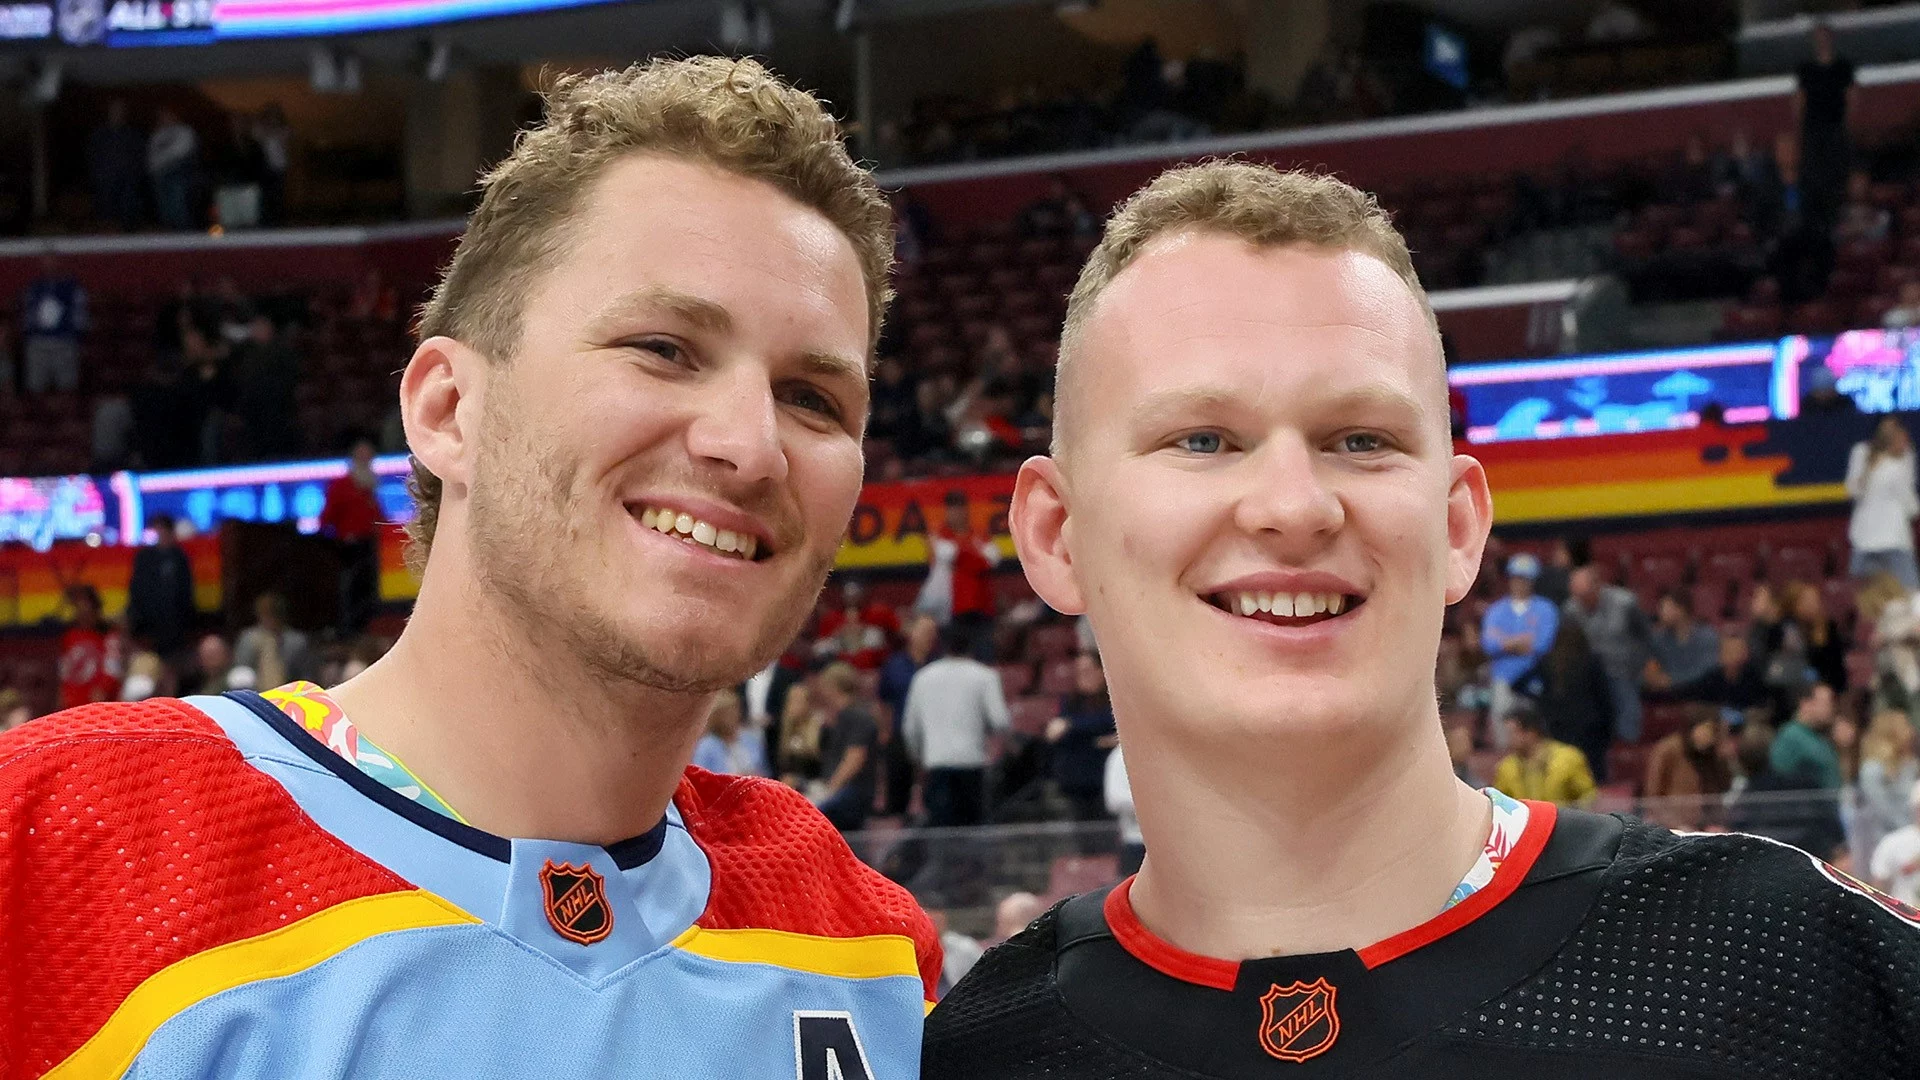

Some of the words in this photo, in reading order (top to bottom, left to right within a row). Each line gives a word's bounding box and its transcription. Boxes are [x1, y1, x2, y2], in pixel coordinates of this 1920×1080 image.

[849, 499, 929, 545] DA
[559, 884, 594, 924] NHL
[1278, 999, 1323, 1045] NHL
